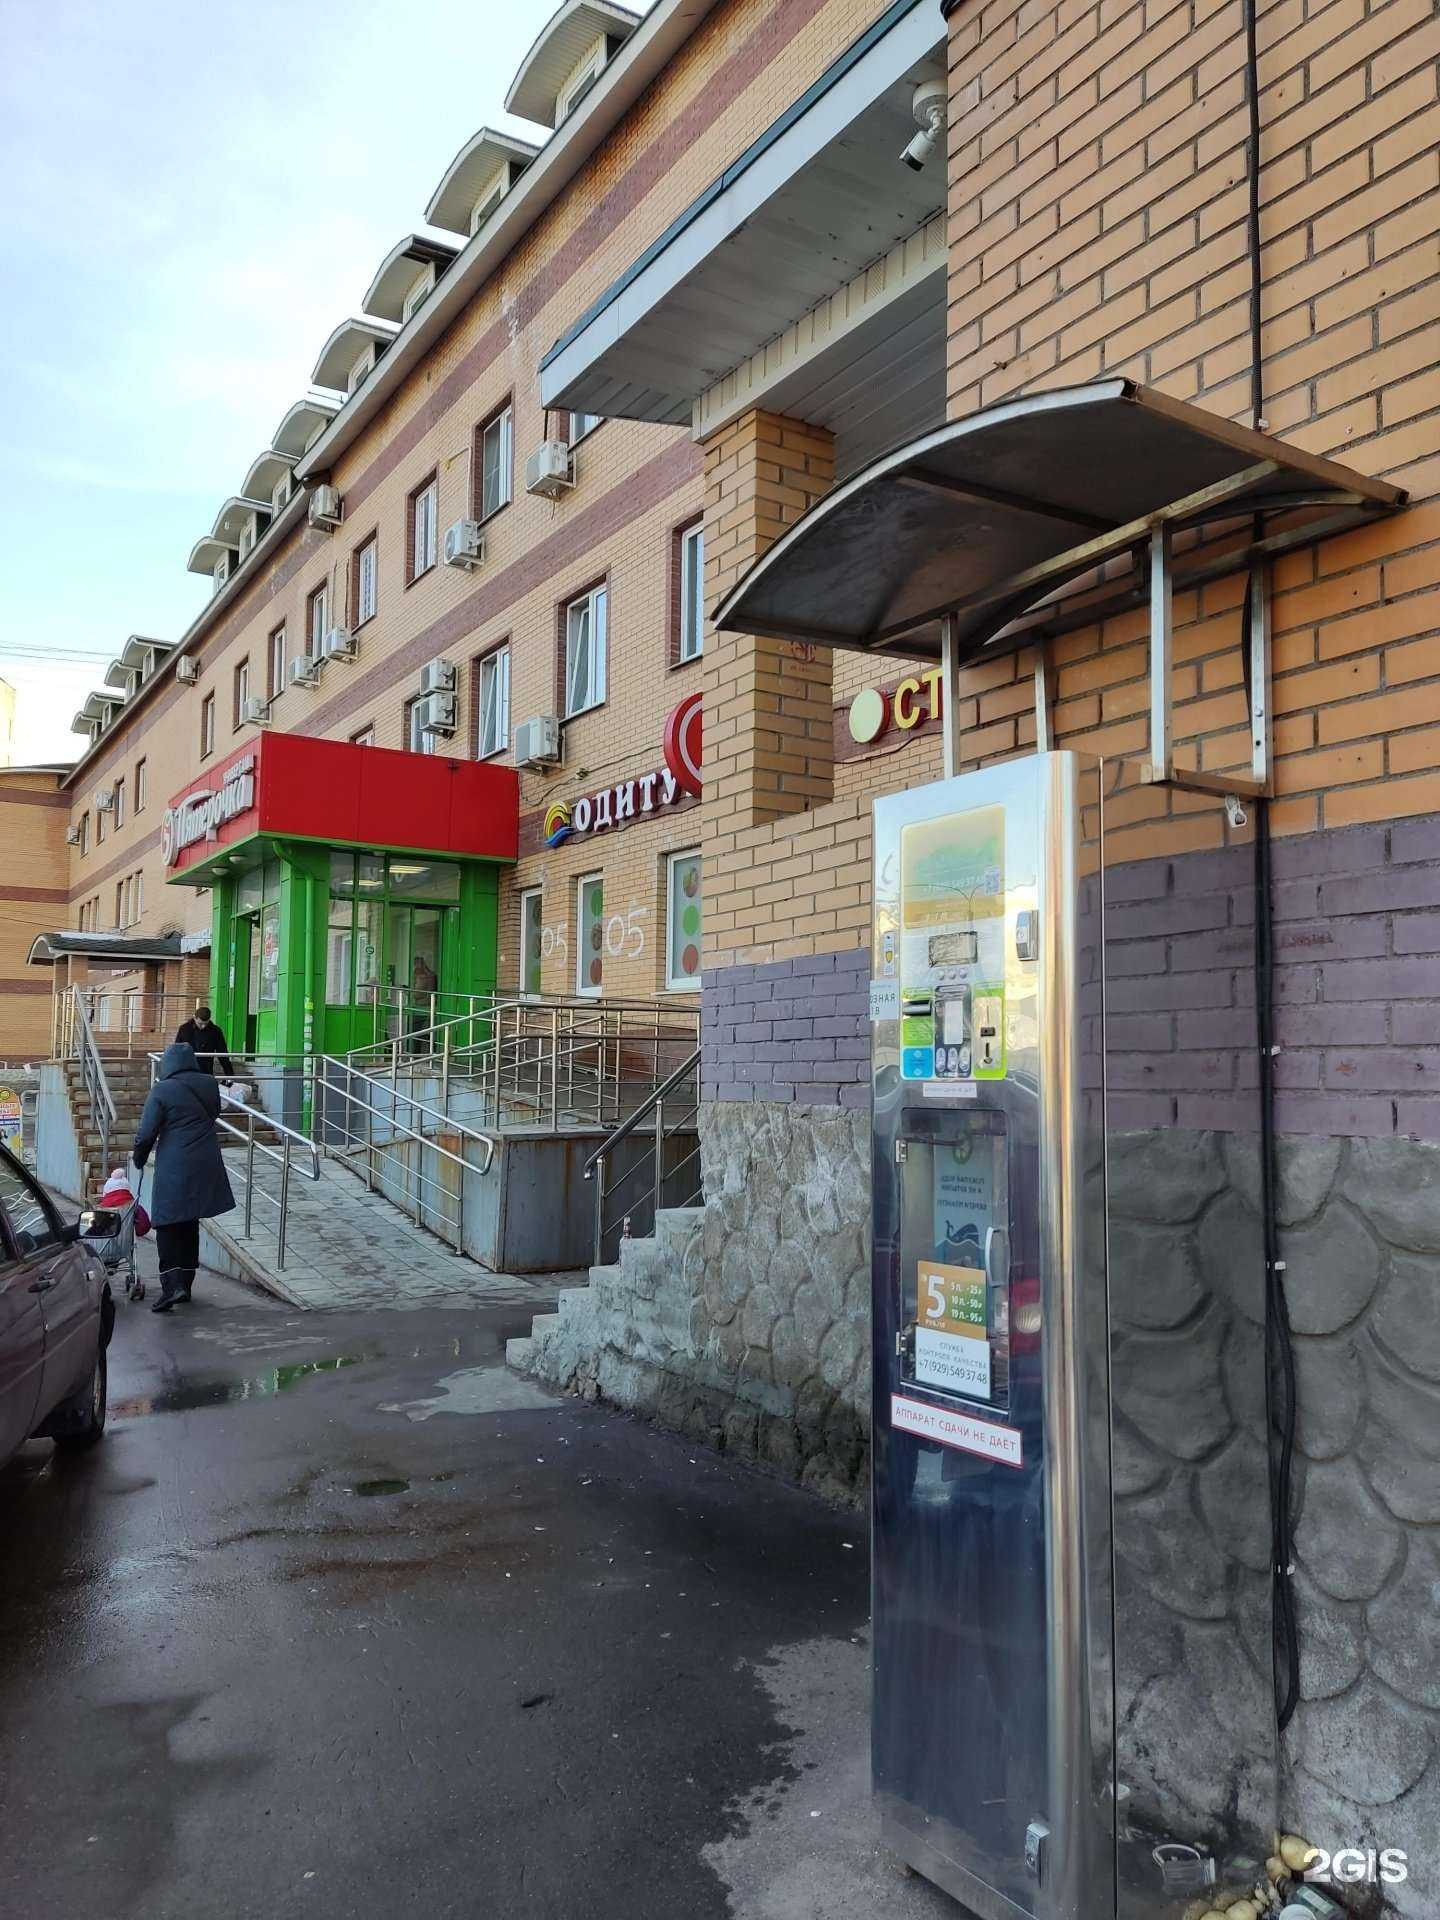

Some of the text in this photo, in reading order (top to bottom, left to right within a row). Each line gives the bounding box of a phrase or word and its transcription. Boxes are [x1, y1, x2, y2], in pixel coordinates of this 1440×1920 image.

[575, 767, 691, 832] ОДИТУ
[926, 1275, 946, 1318] 5
[896, 1406, 1017, 1451] АППАРАТ СДАЧИ НЕ ДАЕТ
